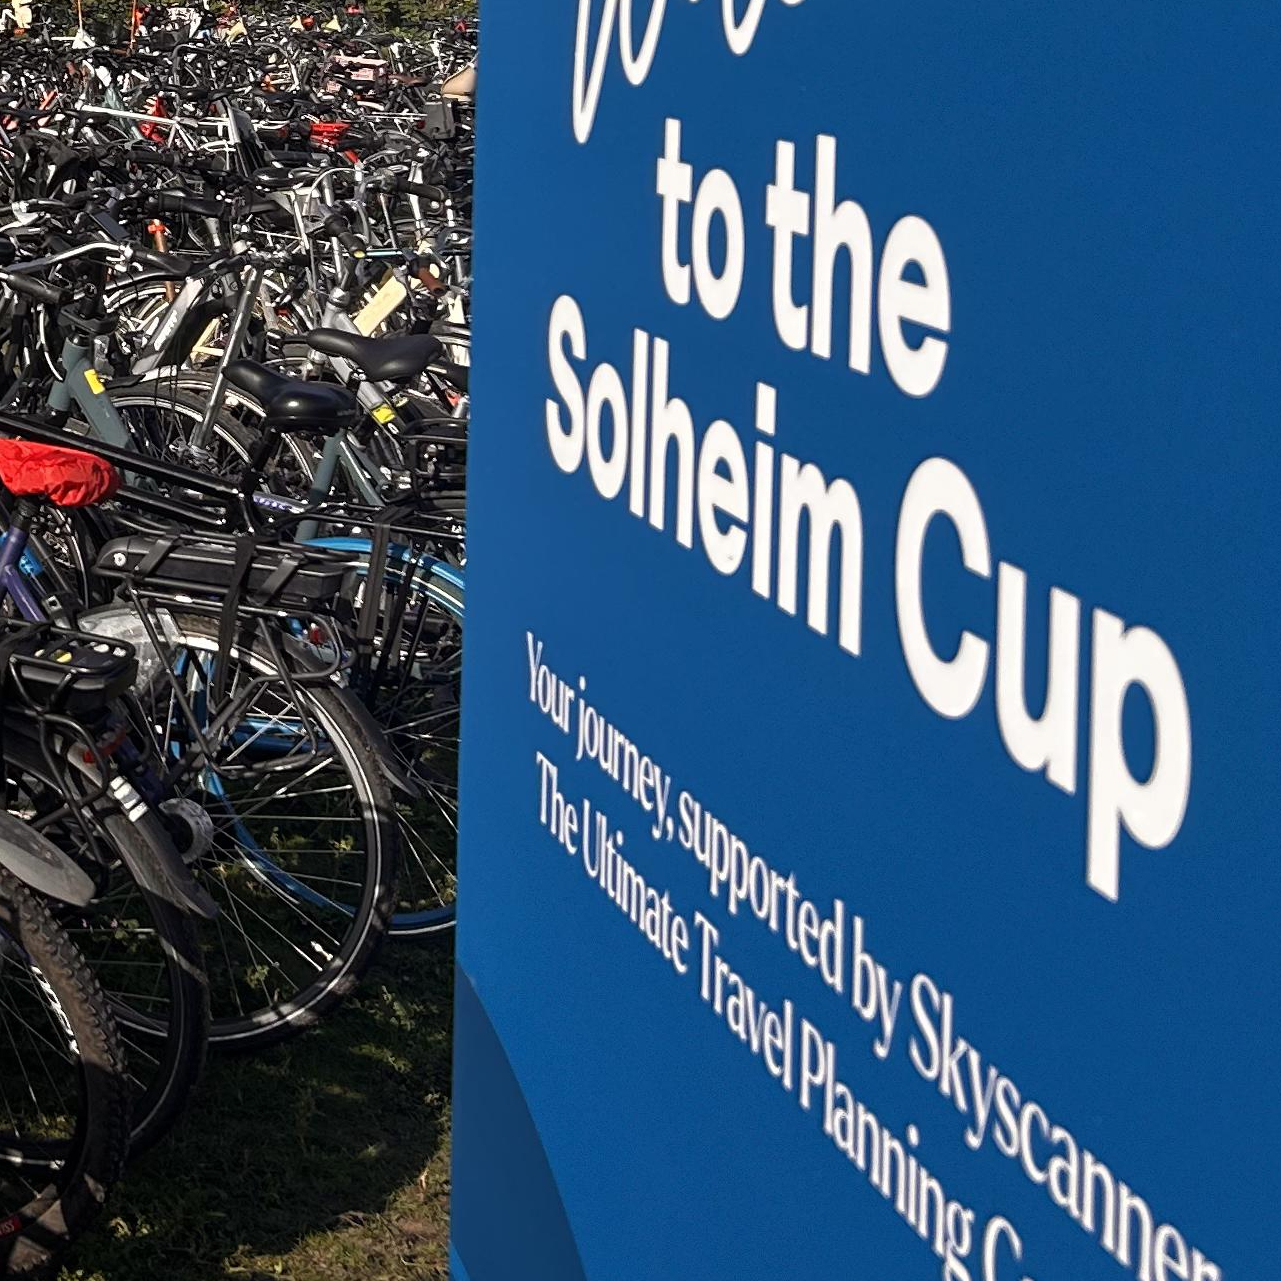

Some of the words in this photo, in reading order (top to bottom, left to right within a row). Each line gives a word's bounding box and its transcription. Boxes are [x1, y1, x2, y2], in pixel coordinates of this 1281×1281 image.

[656, 118, 744, 319] to
[766, 134, 951, 397] the
[546, 295, 863, 656] Solheim
[896, 457, 1192, 901] Cup
[527, 632, 575, 734] Your
[576, 676, 674, 842] journey,
[679, 792, 844, 994] supported
[853, 916, 903, 1058] by
[536, 752, 579, 855] The
[583, 799, 690, 974] Ultimate
[695, 912, 793, 1091] Travel
[800, 1018, 975, 1281] Planning
